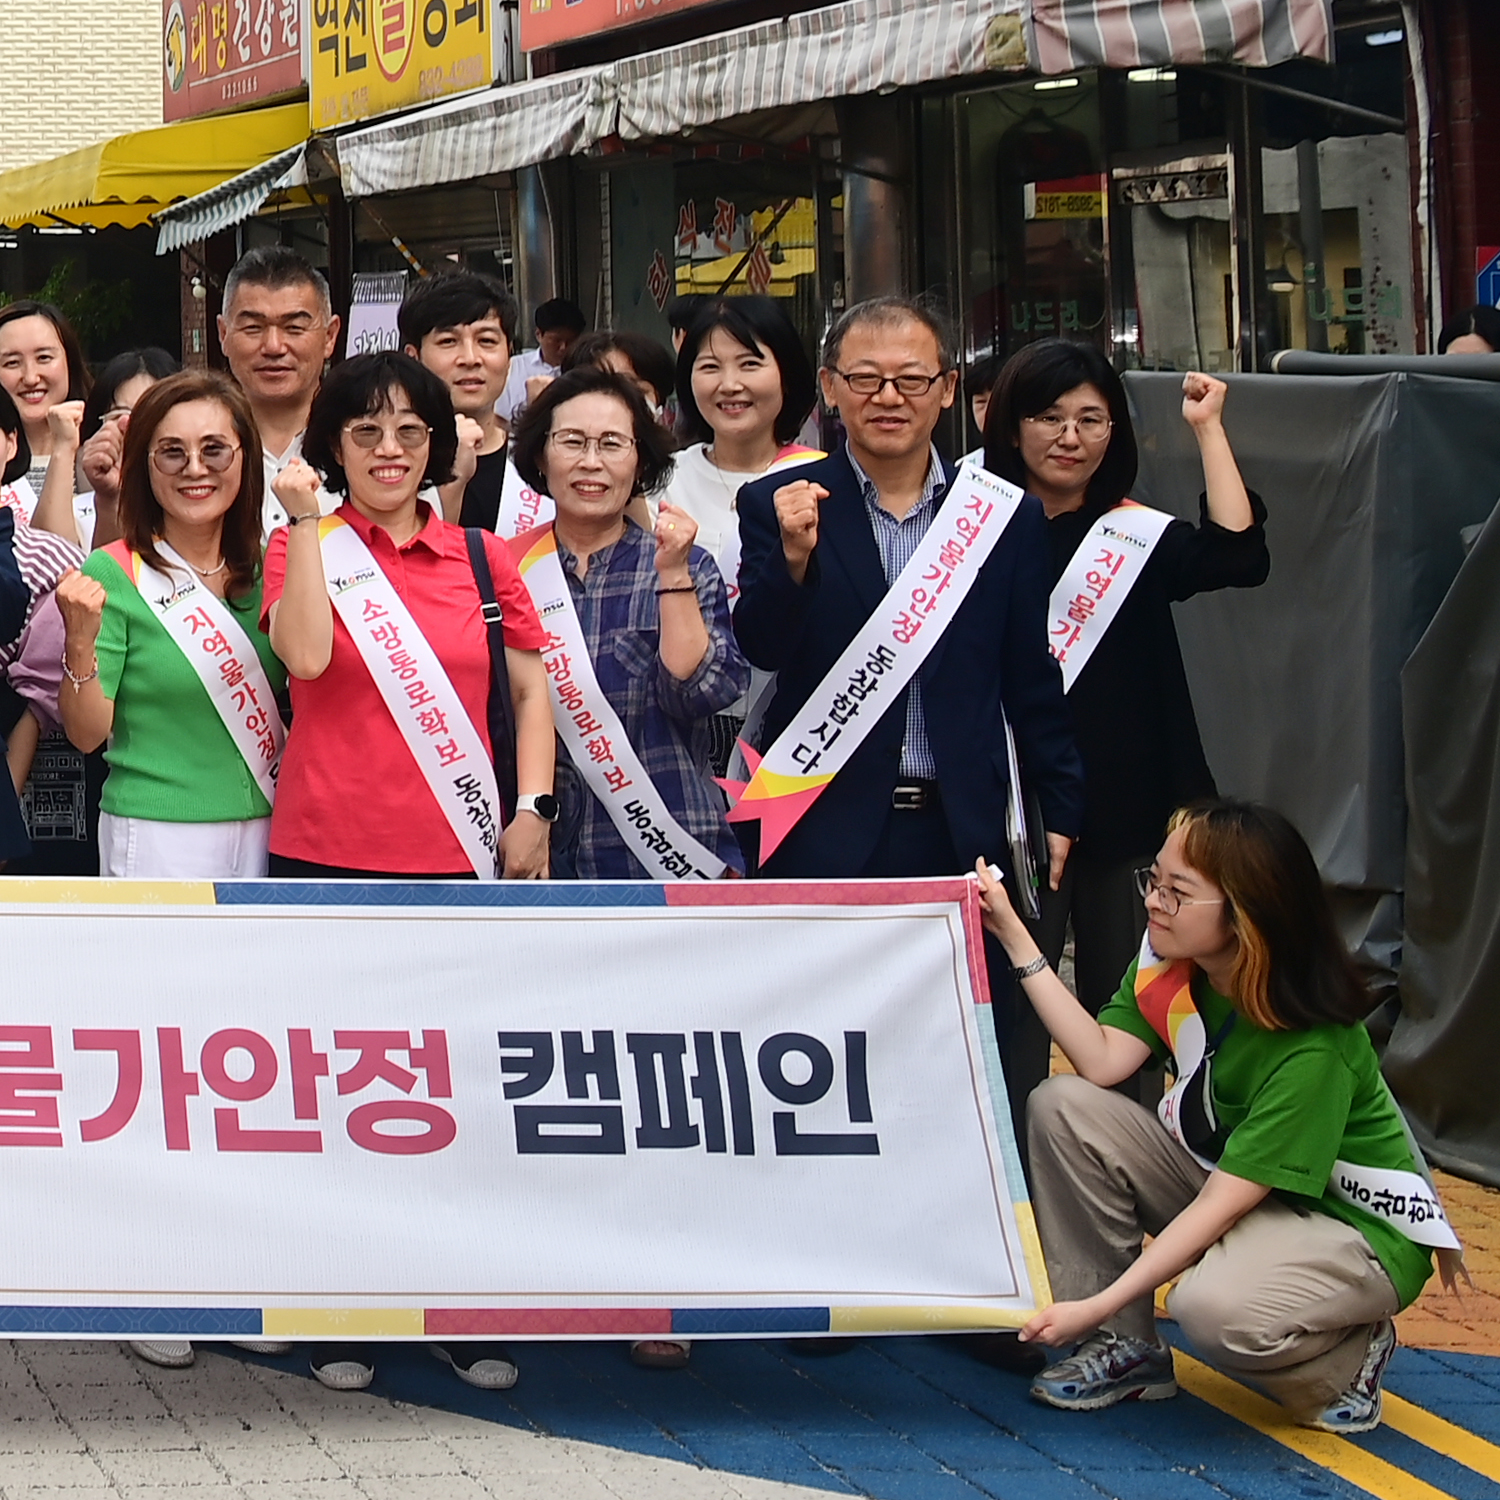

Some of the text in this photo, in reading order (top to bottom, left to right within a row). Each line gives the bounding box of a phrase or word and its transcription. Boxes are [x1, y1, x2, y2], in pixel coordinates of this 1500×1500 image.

[152, 582, 198, 614] Yeonsu
[328, 568, 378, 593] Yeonsu
[789, 493, 995, 776] 지역물가안정 동참합시다
[181, 606, 279, 765] 지역물가안정
[360, 597, 468, 769] 소방통로확보
[494, 1025, 883, 1162] 캠페인
